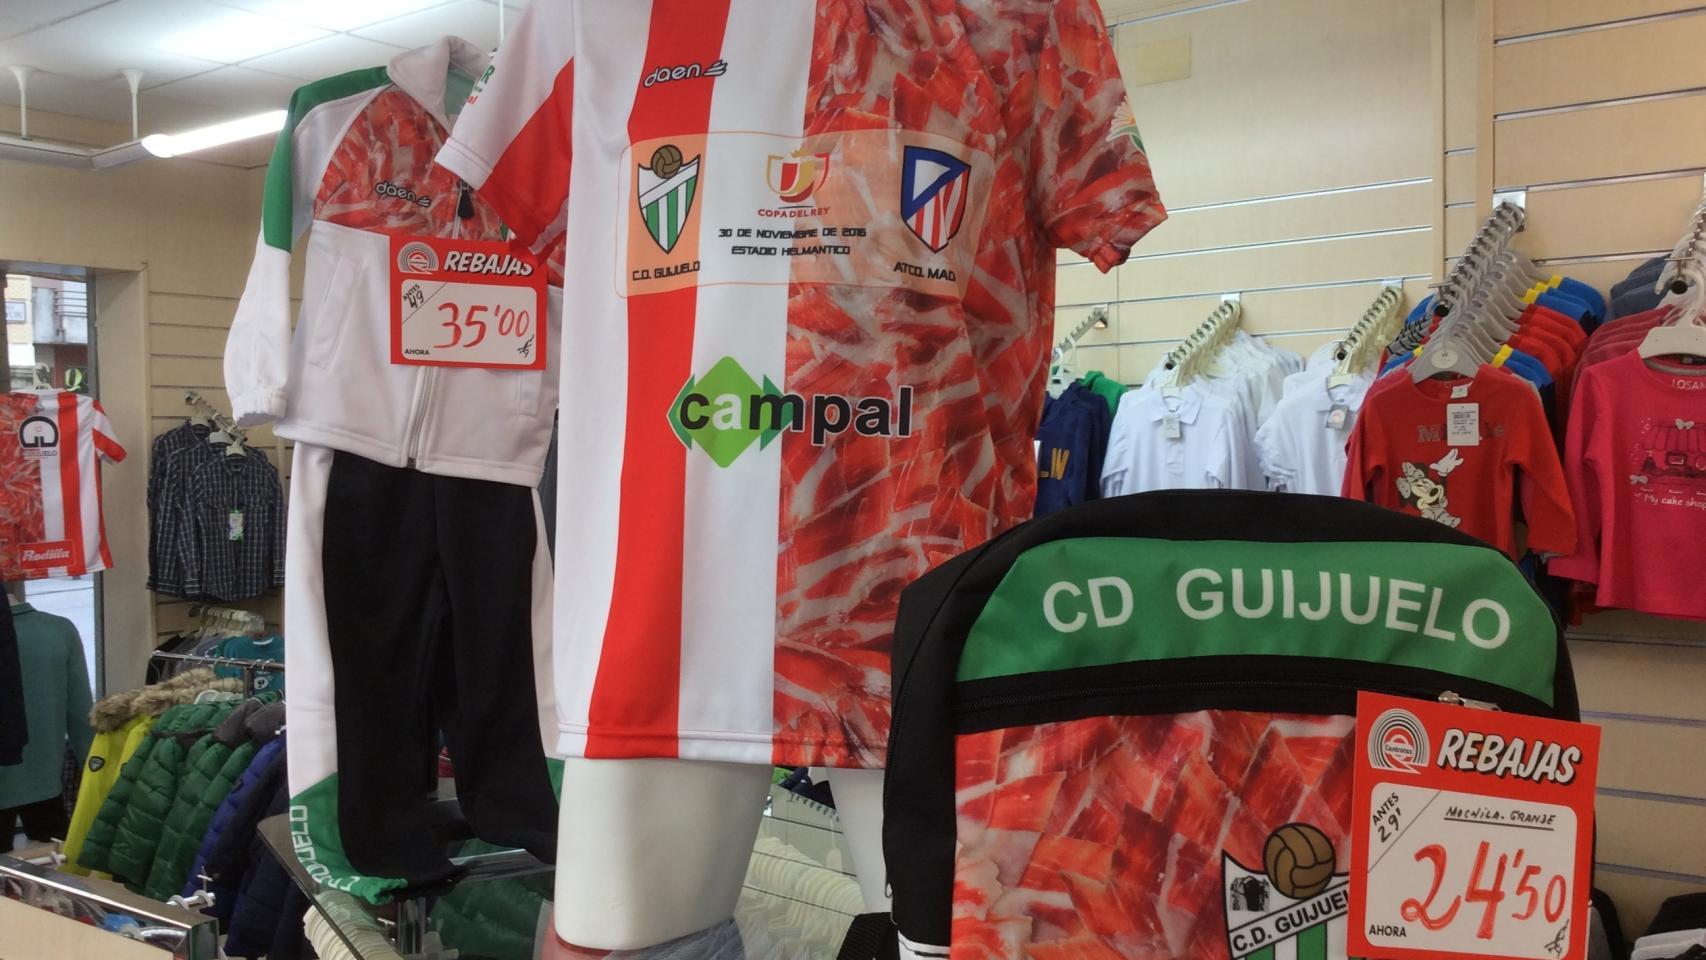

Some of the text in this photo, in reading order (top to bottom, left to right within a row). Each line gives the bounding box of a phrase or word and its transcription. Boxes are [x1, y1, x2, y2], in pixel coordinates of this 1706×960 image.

[643, 63, 702, 87] daen
[375, 181, 417, 200] daen
[757, 206, 831, 218] COPA DEL REY
[718, 227, 867, 239] 30 DE NOVIEMBRE DE 2016
[731, 245, 851, 256] ESTADIO HELMANTICO
[444, 250, 533, 277] REBAJAS
[403, 283, 420, 301] ANTES
[404, 348, 430, 356] AHORA
[679, 385, 913, 446] campal
[1661, 495, 1683, 507] cake
[22, 548, 70, 562] Rodilla
[1043, 567, 1511, 650] CD GUIJUELO
[1437, 728, 1583, 784] REBAJAS
[1371, 792, 1399, 826] ANTES
[1232, 889, 1349, 952] C.D. GUIJUE
[1369, 924, 1407, 938] AHORA
